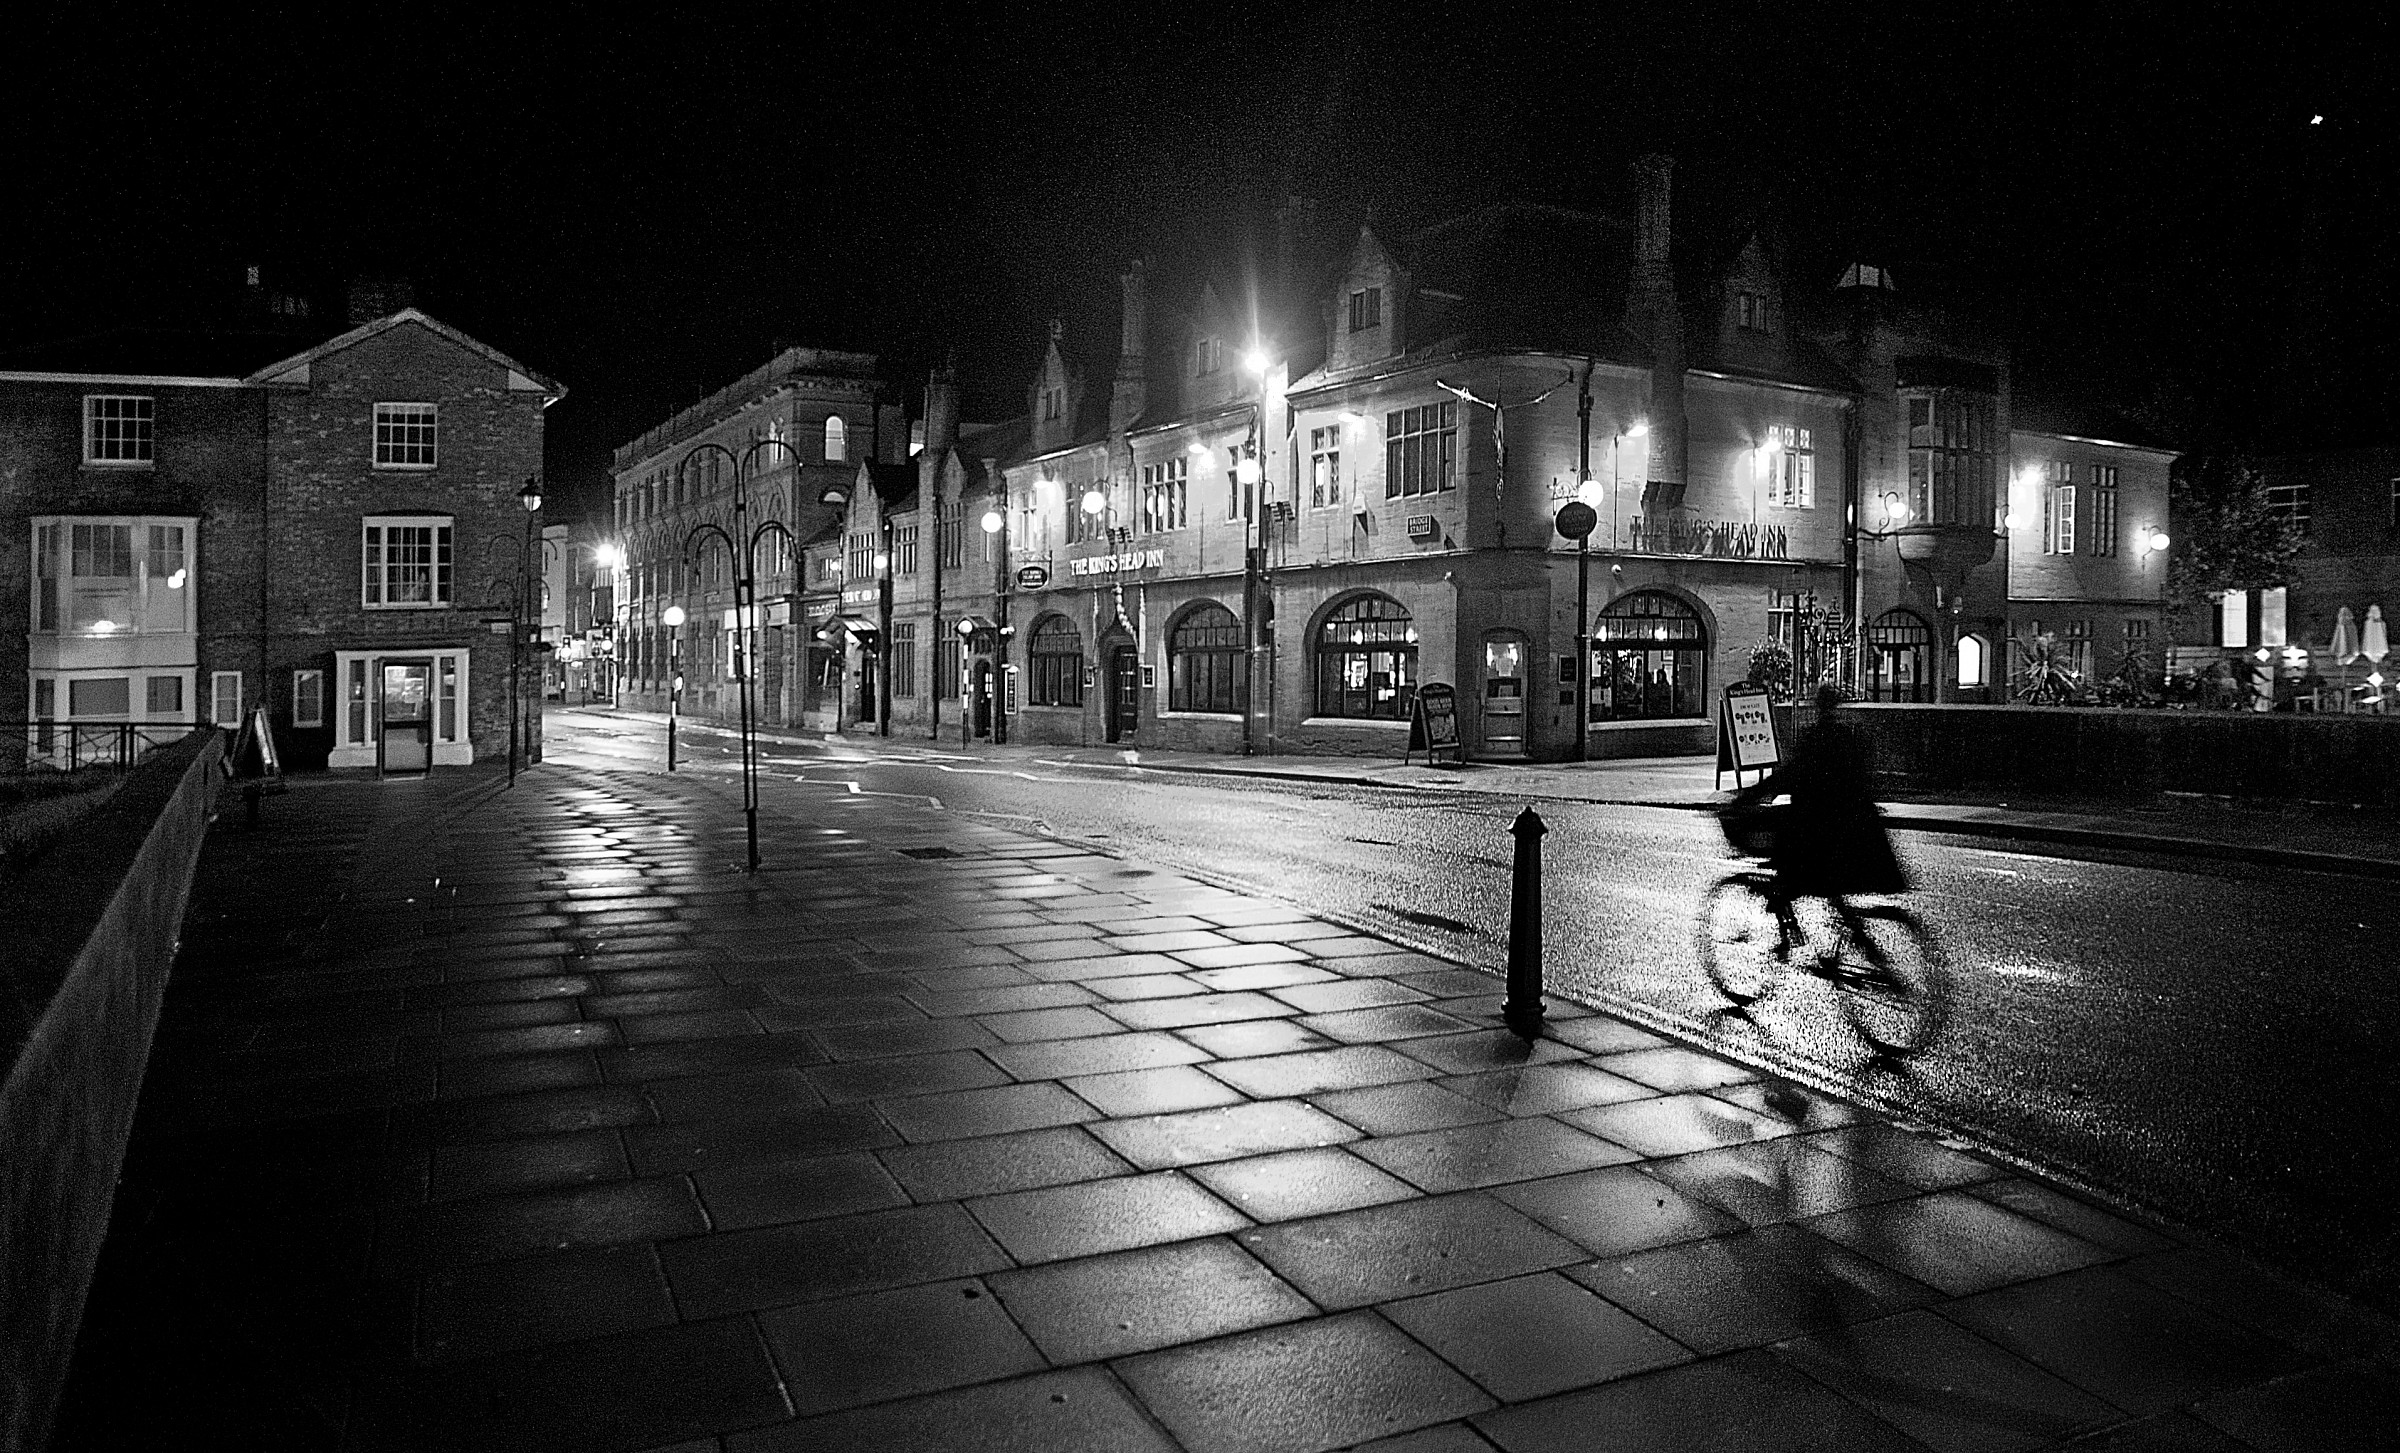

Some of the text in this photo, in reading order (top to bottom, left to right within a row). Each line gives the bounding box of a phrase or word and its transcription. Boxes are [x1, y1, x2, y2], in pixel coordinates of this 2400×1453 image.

[1409, 516, 1428, 526] BRIDGE
[1409, 525, 1428, 534] STREET
[1721, 521, 1758, 541] HEAD
[1070, 549, 1164, 576] THE KING'S HEAD INN
